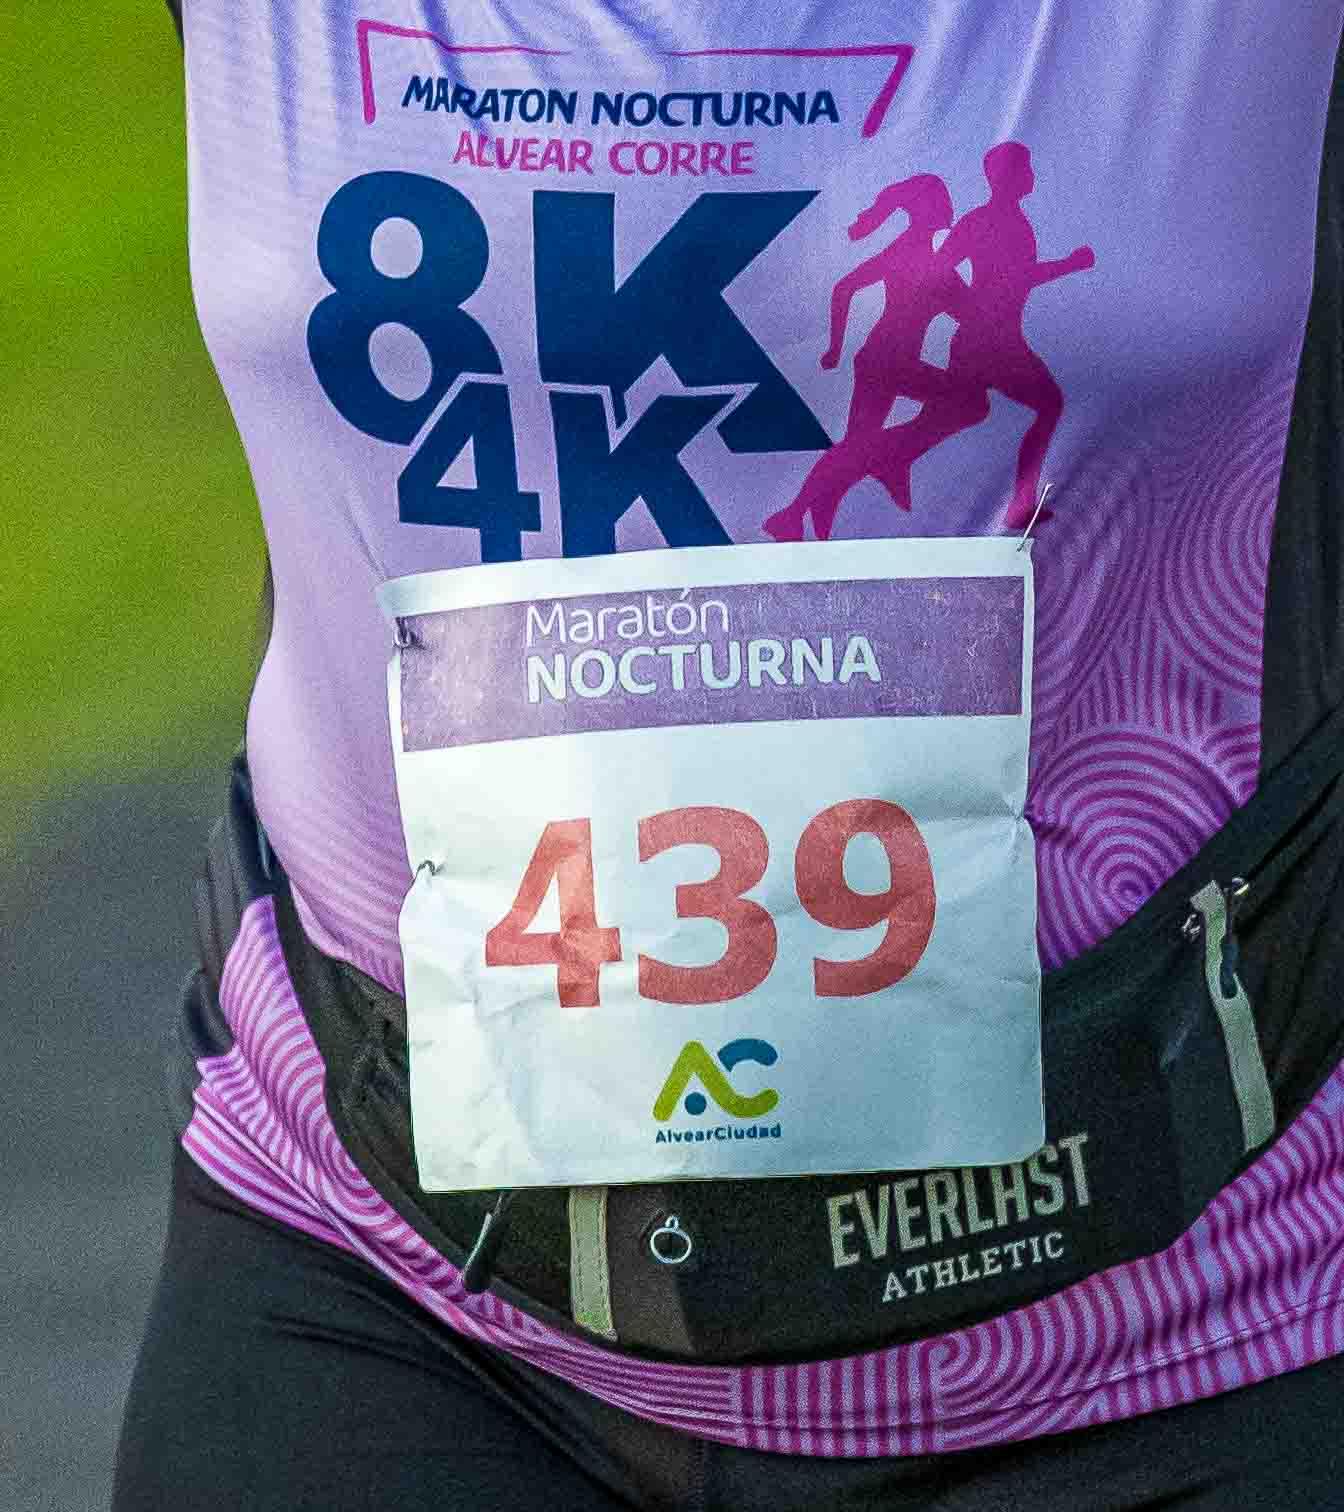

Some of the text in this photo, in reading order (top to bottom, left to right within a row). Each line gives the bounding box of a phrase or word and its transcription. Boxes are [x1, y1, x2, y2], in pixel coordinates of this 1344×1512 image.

[402, 75, 840, 127] MARATON NOCTURNA
[452, 130, 754, 176] ALVEAR CORRE
[307, 171, 834, 454] 8K
[397, 380, 735, 563] 4K
[525, 586, 730, 648] Maratón
[526, 635, 882, 704] NOCTURNA
[485, 798, 936, 1009] 439
[655, 1122, 782, 1144] AlvearCiudad
[827, 1132, 1090, 1268] EVERLAST
[882, 1231, 1065, 1303] ATHLETIC
